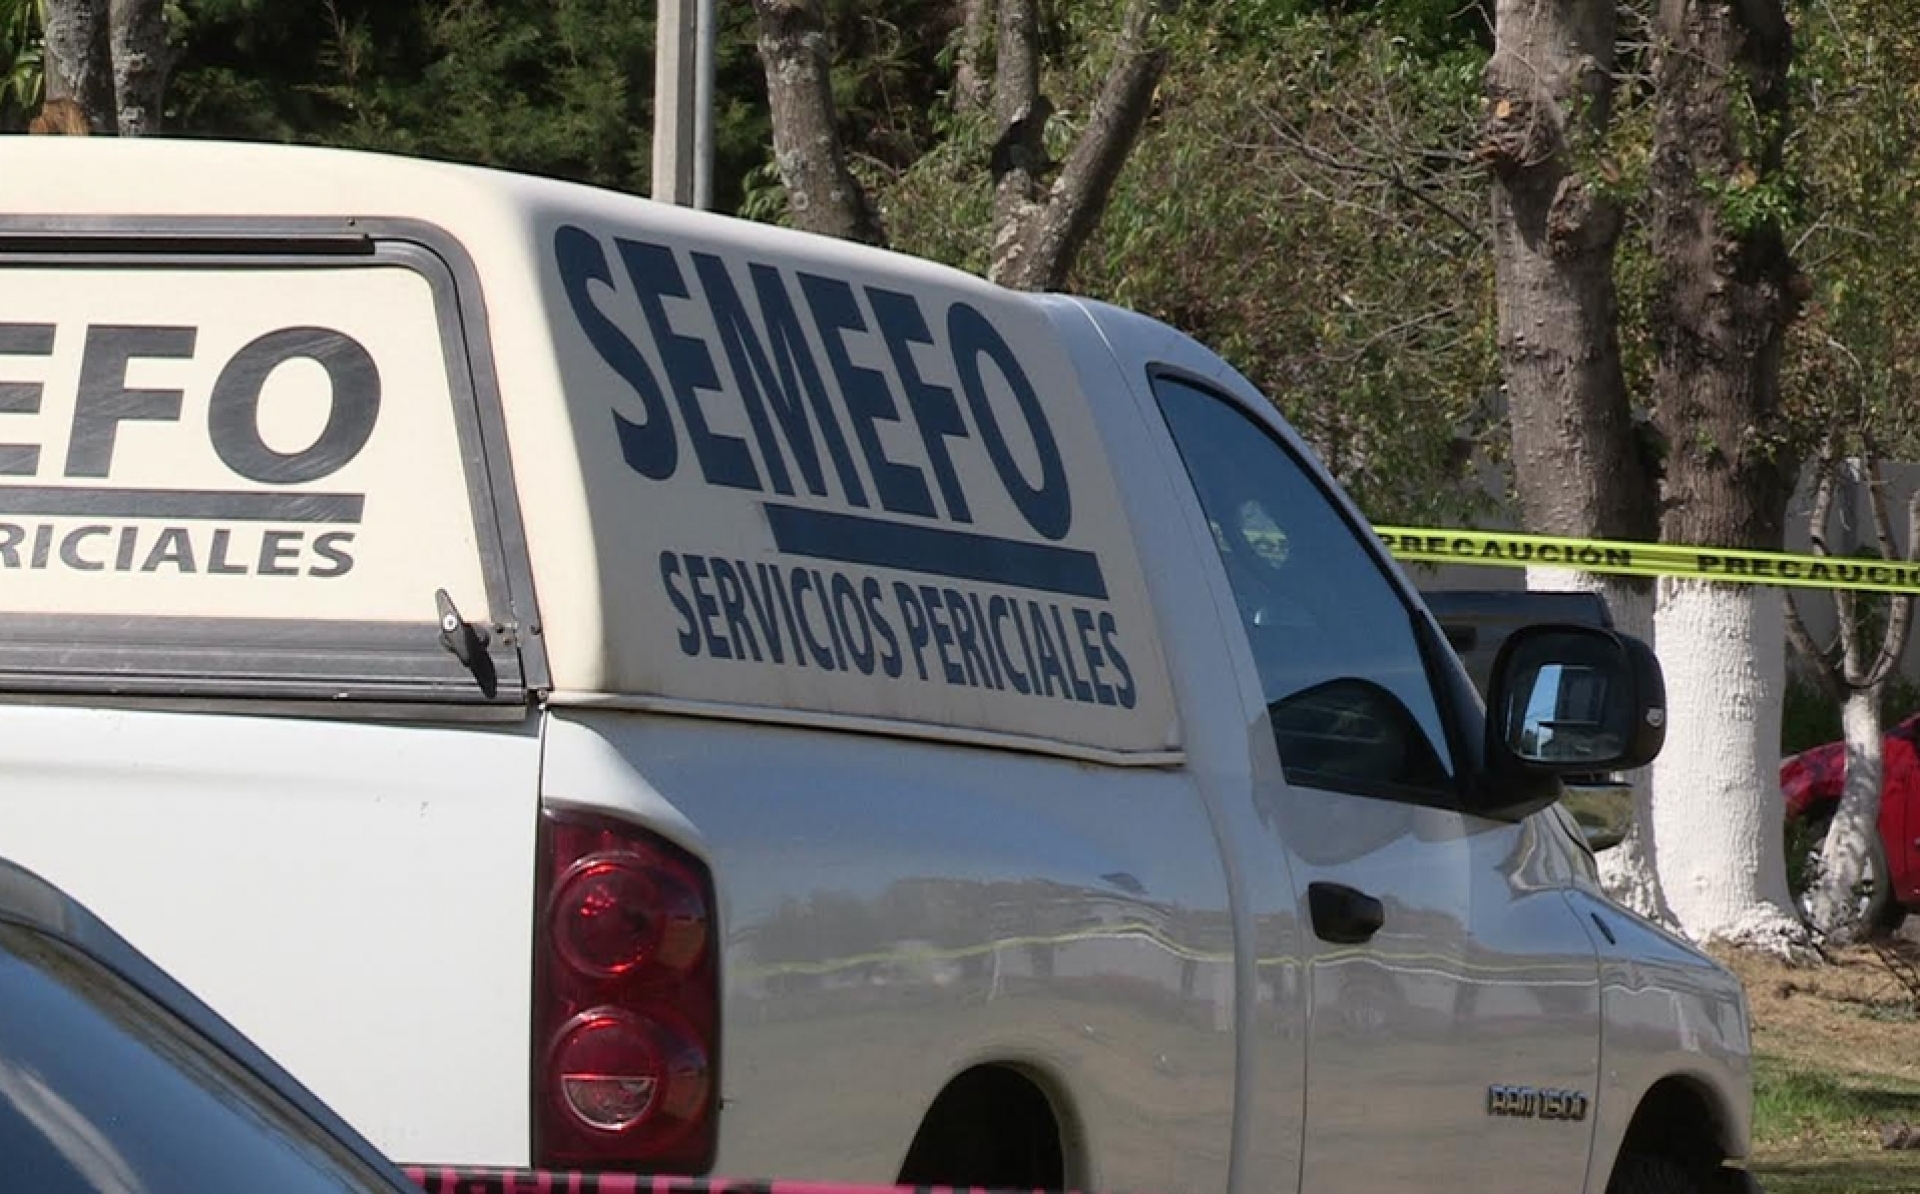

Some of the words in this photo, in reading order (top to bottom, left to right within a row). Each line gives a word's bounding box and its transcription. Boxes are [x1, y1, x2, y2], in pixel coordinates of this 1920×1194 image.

[554, 225, 1072, 540] SEMEFO
[659, 550, 901, 678] SERVICIOS
[893, 581, 1137, 709] PERICIALES
[1487, 1085, 1536, 1118] RAM
